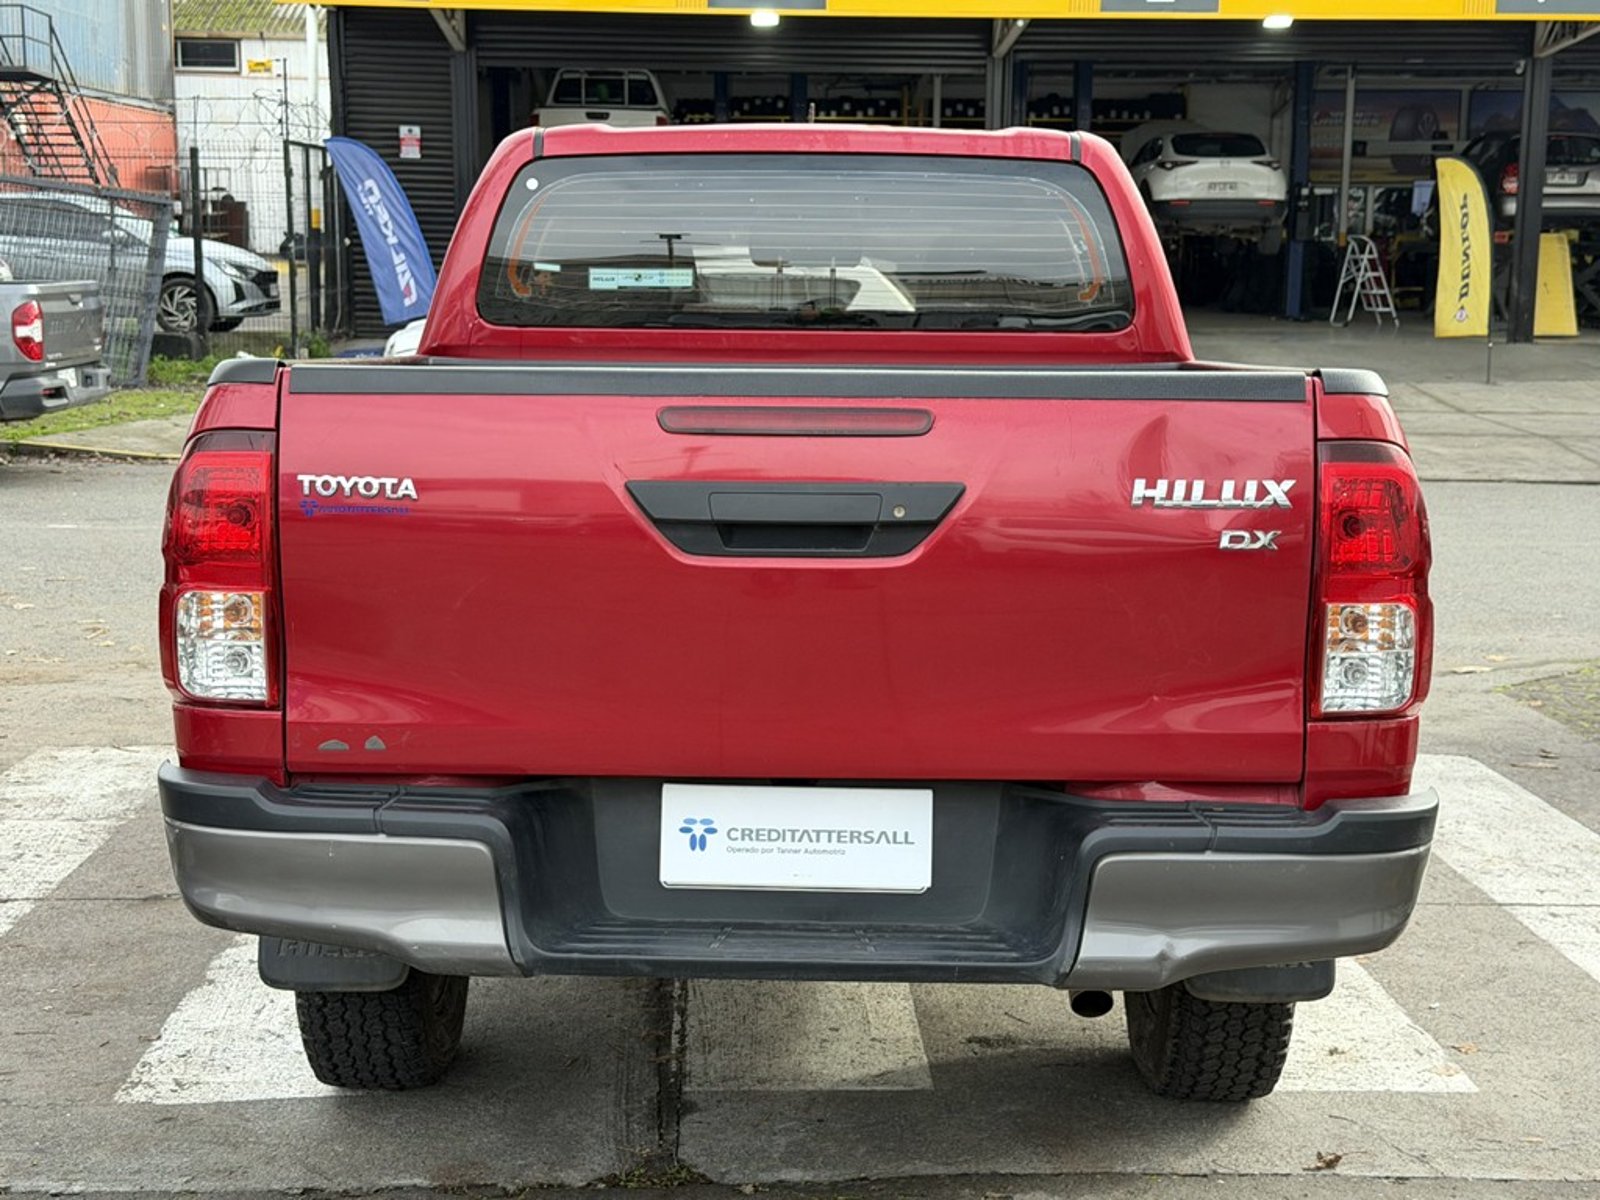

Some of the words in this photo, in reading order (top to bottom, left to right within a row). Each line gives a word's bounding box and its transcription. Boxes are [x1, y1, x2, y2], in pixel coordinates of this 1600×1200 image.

[297, 474, 418, 500] TOYOTA
[1131, 478, 1297, 509] HILUX
[1219, 529, 1282, 550] DX
[726, 827, 915, 845] CREDITATTERSALL
[726, 846, 759, 854] Operado
[777, 846, 801, 854] Tanner
[803, 847, 846, 856] Automotriz
